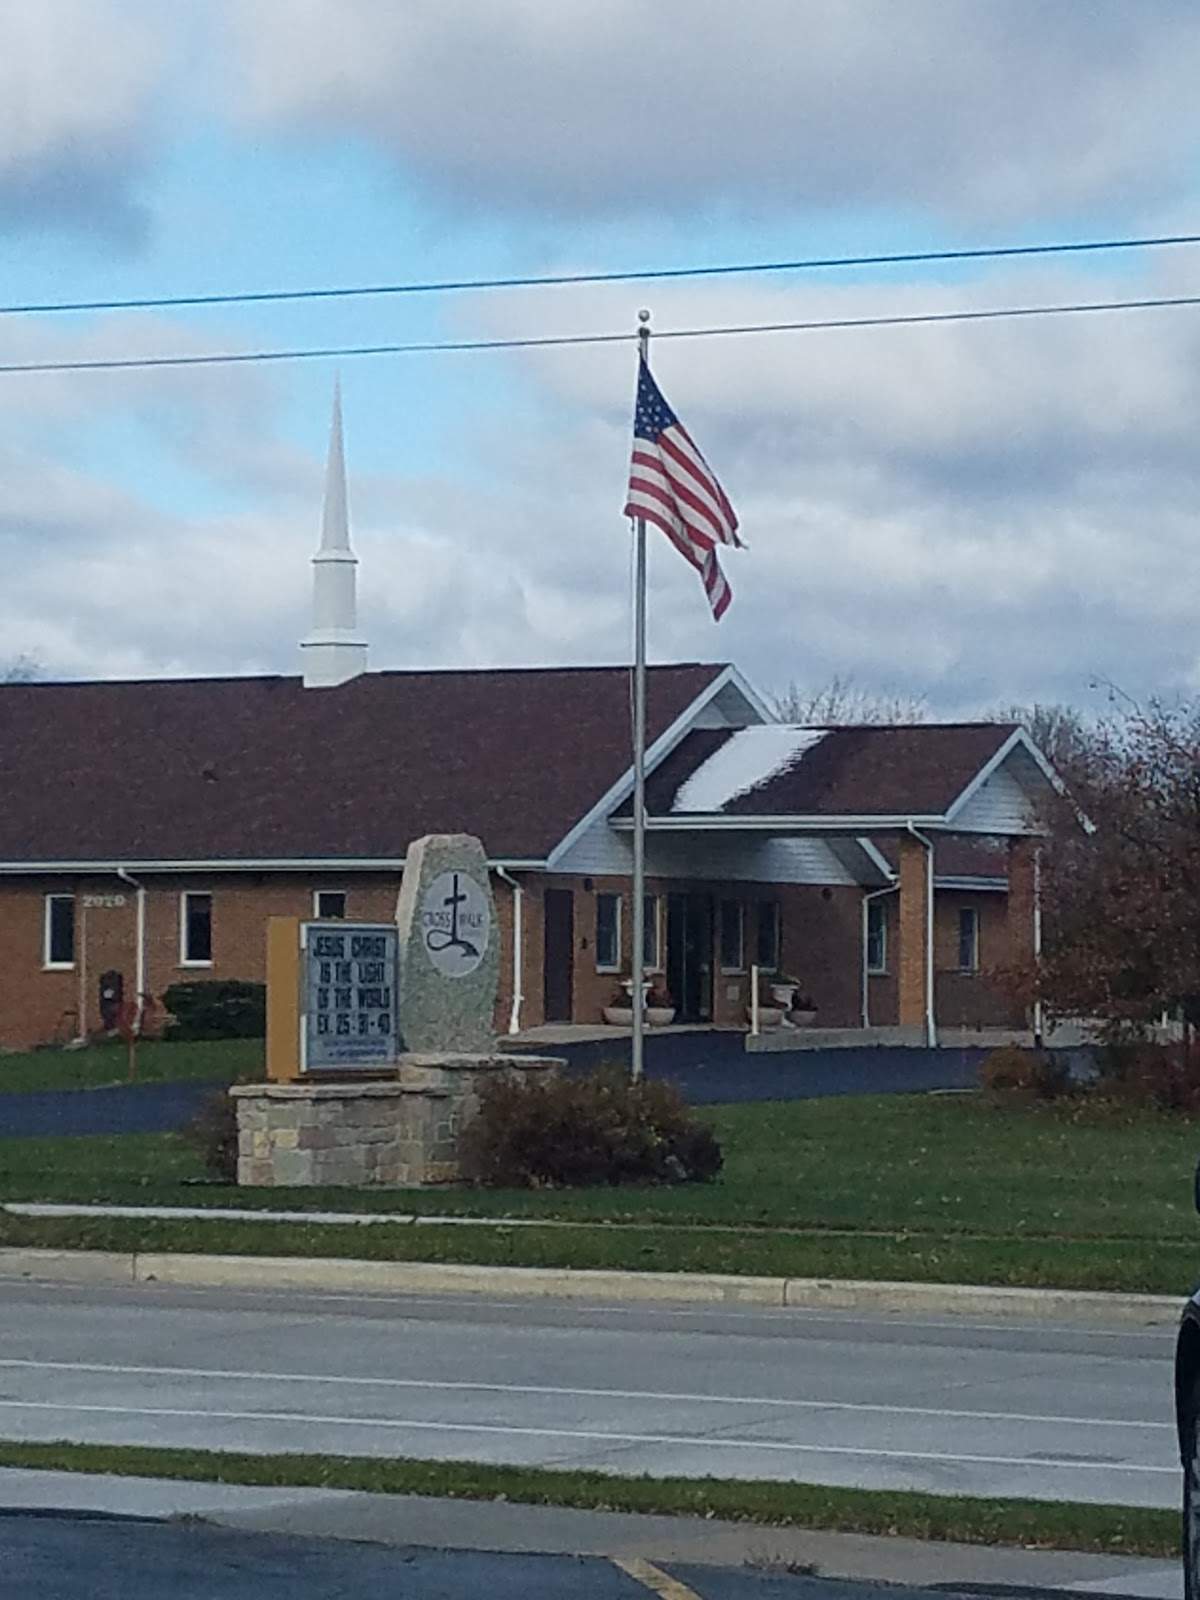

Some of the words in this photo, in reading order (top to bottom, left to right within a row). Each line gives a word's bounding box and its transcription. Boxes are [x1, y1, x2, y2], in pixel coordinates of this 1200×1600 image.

[313, 936, 344, 958] JESUS
[351, 936, 386, 958] CHRIST
[320, 961, 331, 983] IS
[335, 961, 352, 983] THE
[358, 961, 385, 983] LIGHT
[317, 987, 329, 1009] OF
[334, 987, 352, 1009] THE
[357, 987, 390, 1009] WORLD
